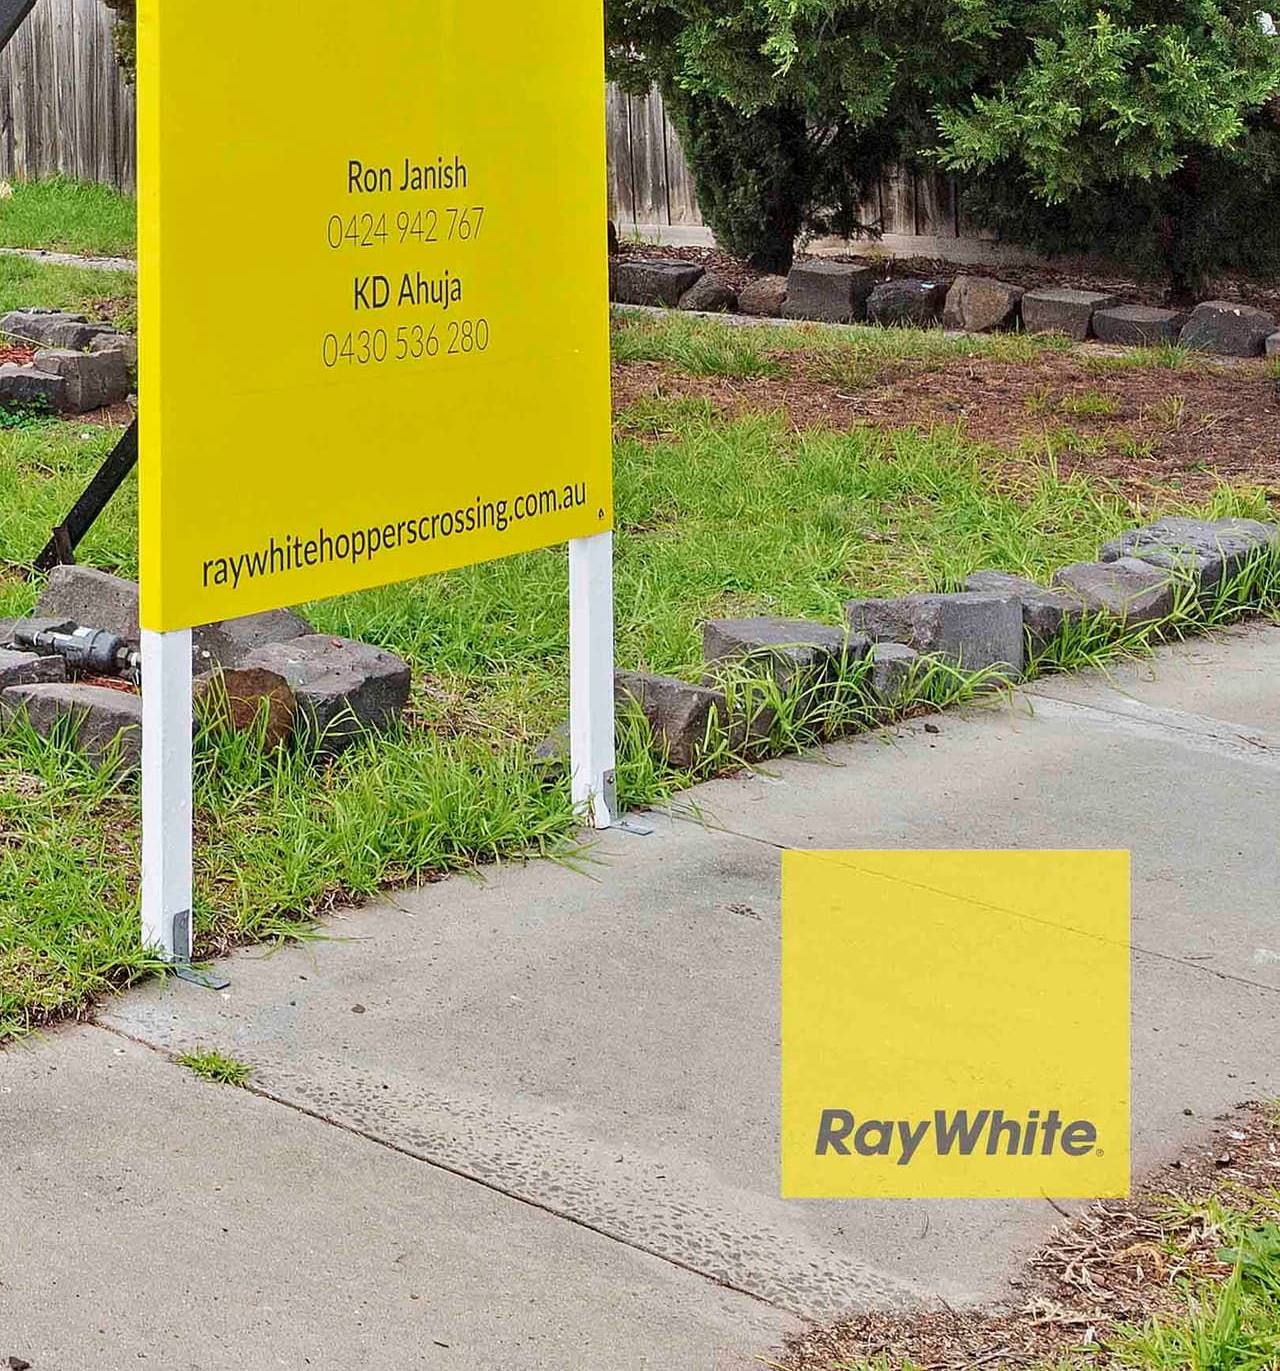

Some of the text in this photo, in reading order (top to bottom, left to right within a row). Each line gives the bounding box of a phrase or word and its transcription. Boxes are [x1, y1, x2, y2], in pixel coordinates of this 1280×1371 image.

[347, 156, 467, 193] Ron Janish
[327, 207, 485, 249] 0424 942 767
[354, 270, 462, 310] KD Ahuja
[322, 318, 490, 367] 0430 536 280
[202, 481, 587, 589] raywhitehopperscrossing.com.au
